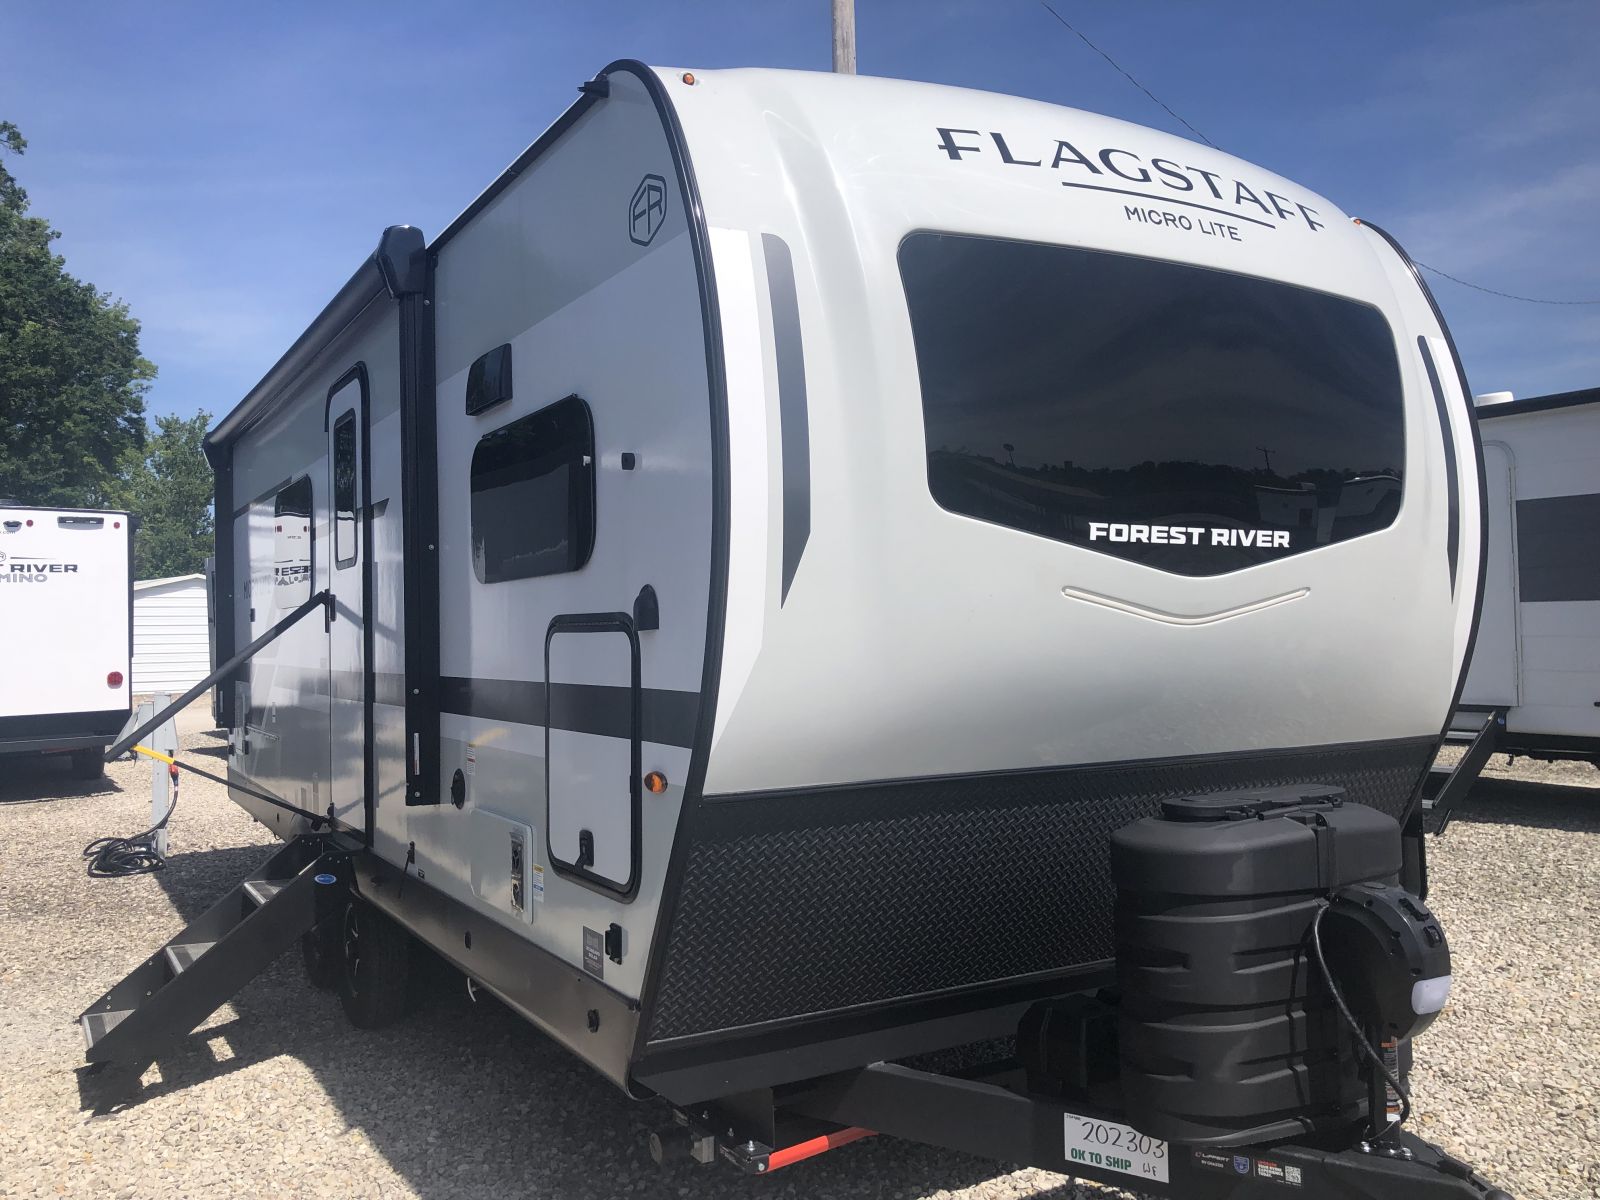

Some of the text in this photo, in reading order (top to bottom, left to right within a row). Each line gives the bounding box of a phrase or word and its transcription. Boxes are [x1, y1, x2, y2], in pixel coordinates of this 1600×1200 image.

[936, 127, 1325, 231] FLAGSTAFF
[1124, 205, 1242, 242] MICRO LITE
[1089, 522, 1290, 548] FOREST RIVER
[9, 564, 78, 573] RIVER
[1081, 1121, 1165, 1159] 202303
[1070, 1147, 1132, 1171] OK TO SHIP
